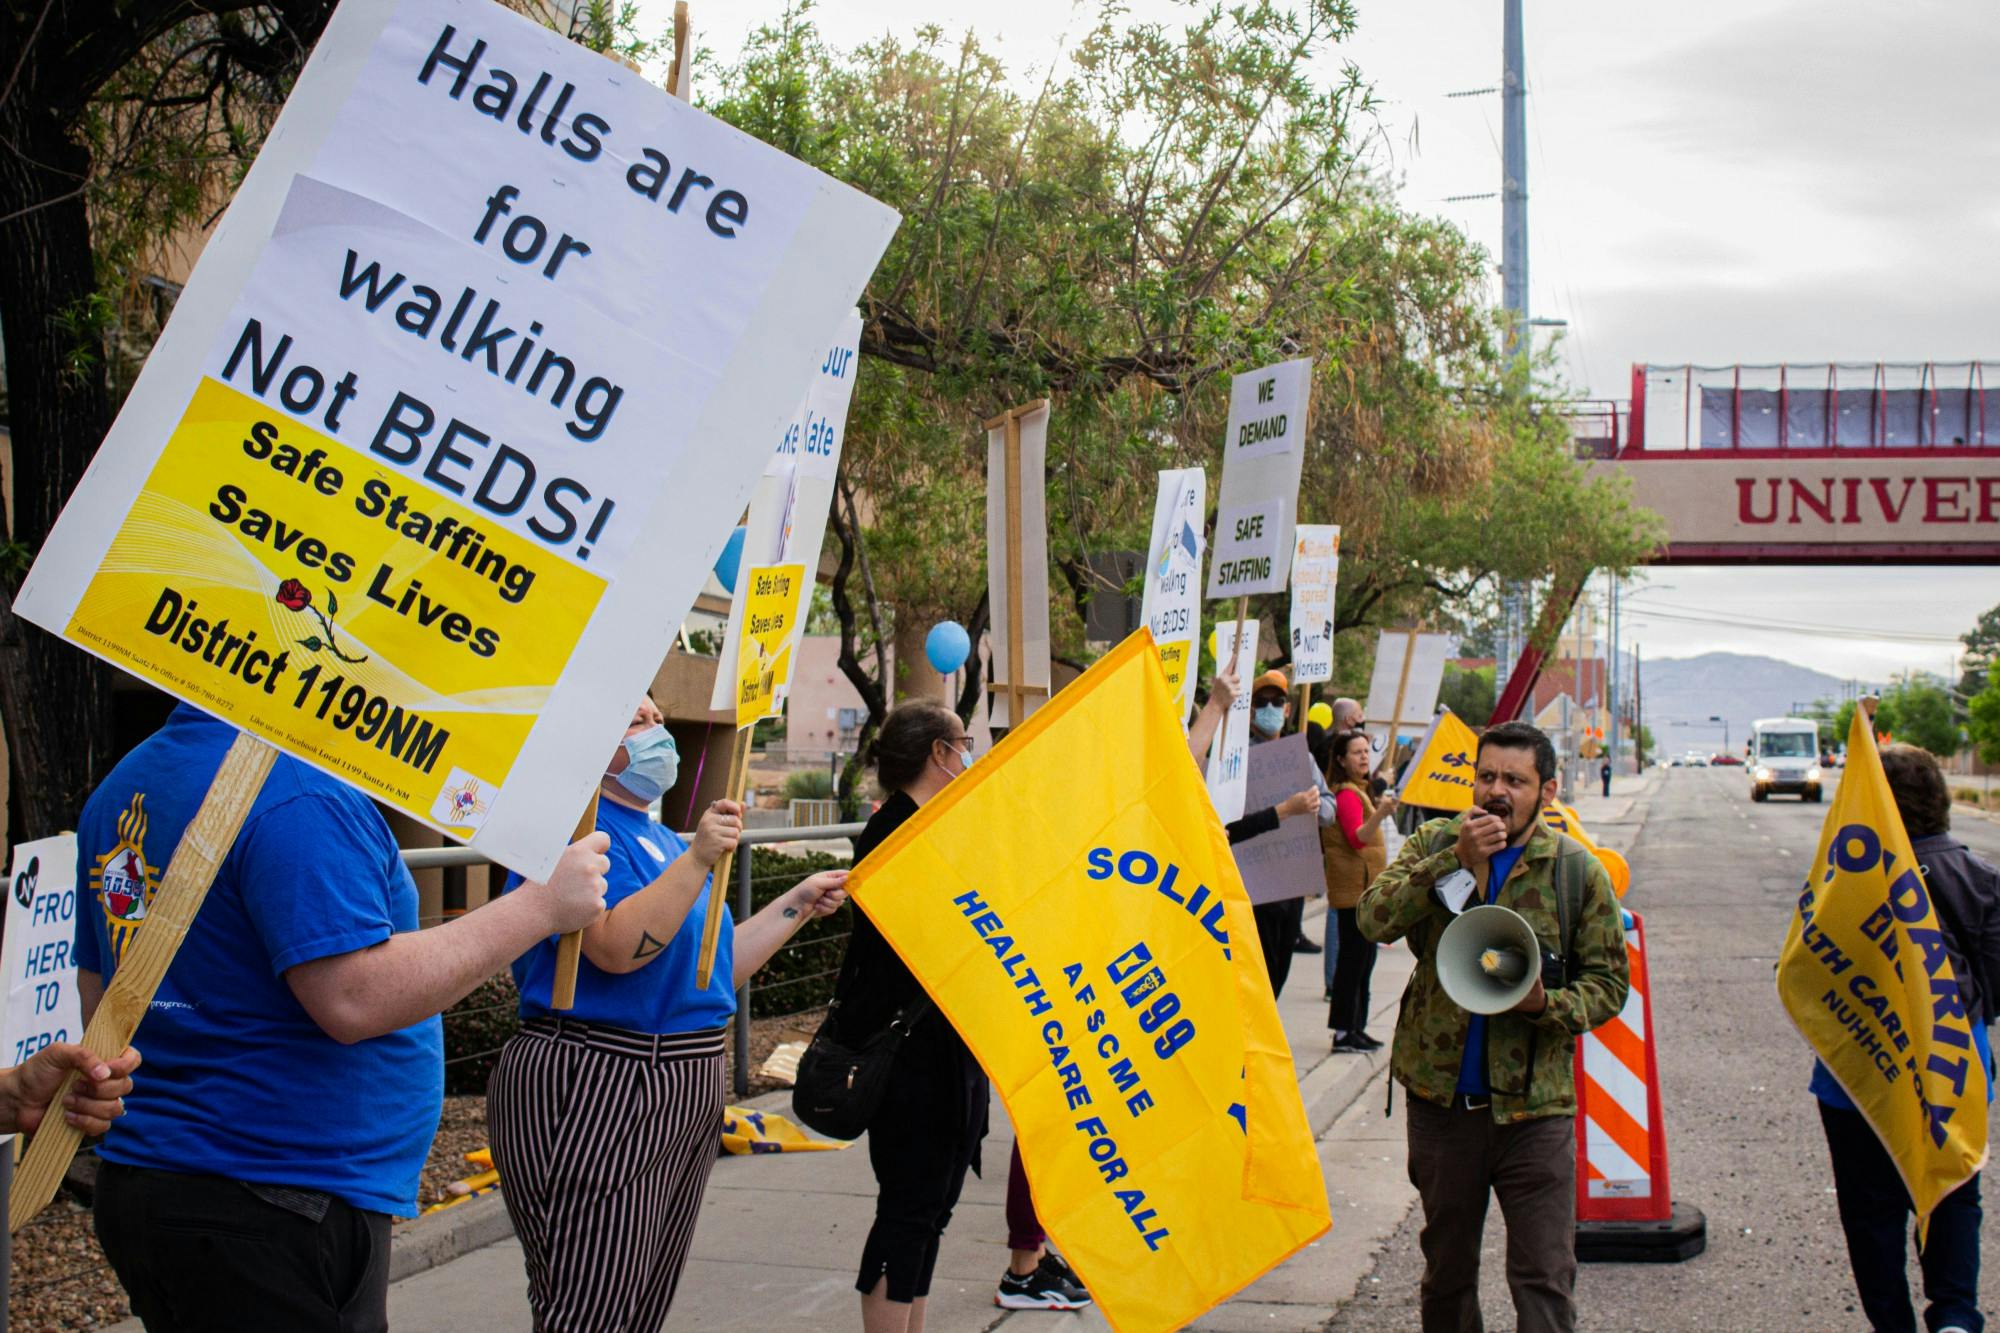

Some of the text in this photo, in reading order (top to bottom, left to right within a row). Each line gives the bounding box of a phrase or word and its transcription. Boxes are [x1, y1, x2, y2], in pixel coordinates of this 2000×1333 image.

[417, 23, 749, 237] Halls are
[473, 184, 591, 279] for
[339, 248, 624, 442] walking
[1258, 378, 1276, 404] WE
[221, 318, 615, 559] Not BEDS!
[1239, 414, 1287, 447] DEMAND
[242, 421, 536, 604] Safe Staffing
[1235, 515, 1265, 542] SAFE
[209, 484, 500, 658] Saves Lives
[1218, 556, 1271, 586] STAFFING
[78, 626, 102, 643] District
[103, 639, 131, 657] 1199NM
[160, 668, 178, 683] Office
[143, 587, 450, 775] District 1199NM
[1304, 634, 1320, 653] NOT
[249, 714, 410, 801] Like us on Facebook Local 1199 Santa Fe NM
[32, 889, 75, 928] FRO
[35, 981, 60, 1016] TO
[1799, 880, 1854, 976] EALTH
[1848, 974, 1910, 1053] CARE
[952, 888, 1170, 1252] HEALTH CARE FOR ALL
[1062, 962, 1154, 1119] AFSCME
[1821, 988, 1901, 1084] NUHHCE
